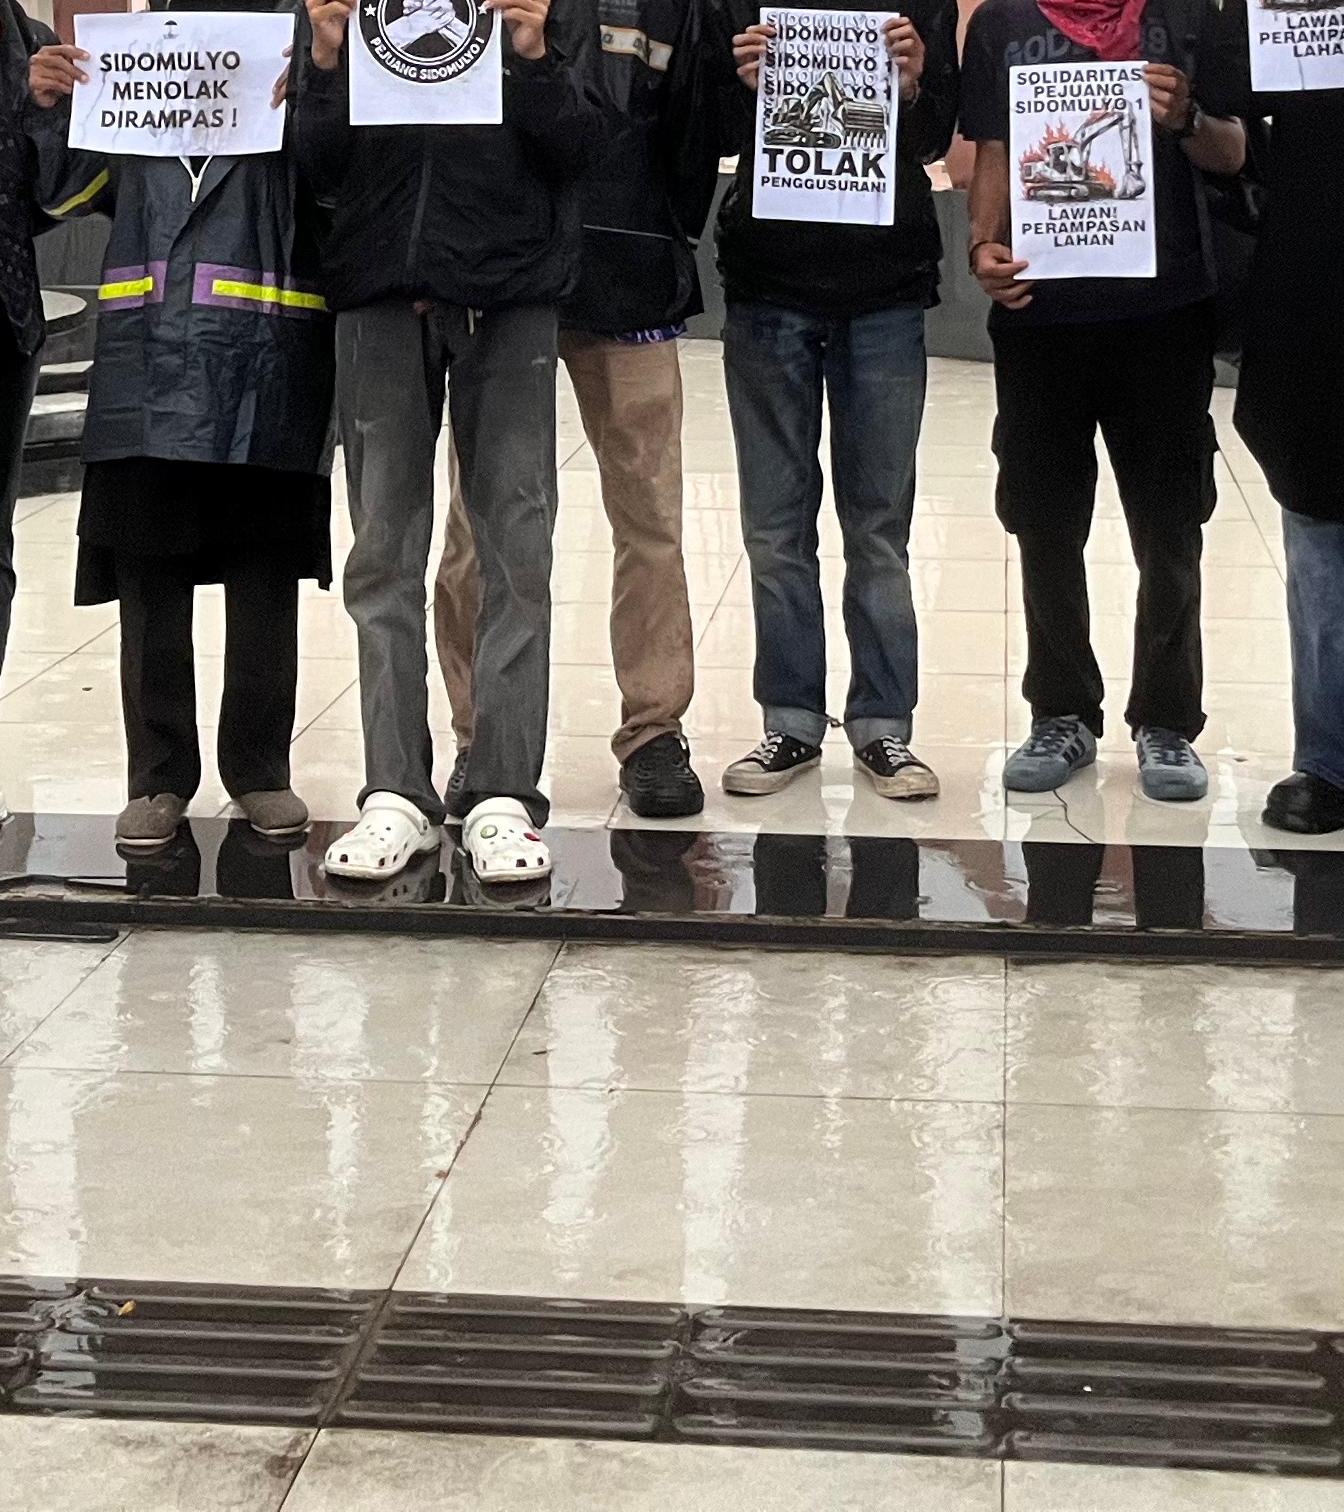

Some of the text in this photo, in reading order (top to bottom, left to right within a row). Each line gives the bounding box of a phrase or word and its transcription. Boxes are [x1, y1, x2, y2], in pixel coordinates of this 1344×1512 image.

[100, 51, 241, 72] SIDOMULYO
[369, 36, 418, 79] PEJUANG
[419, 42, 481, 81] SIDOMULYO
[1017, 68, 1143, 86] SOLIDARITAS
[112, 80, 229, 101] MENOLAK
[1034, 83, 1124, 99] PEJUANG
[1015, 98, 1143, 114] SIDOMULYO 1
[101, 109, 224, 129] DIRAMPAS
[762, 147, 886, 179] TOLAK
[1048, 206, 1117, 221] LAWAN!
[1022, 219, 1146, 235] PERAMPASAN
[1054, 233, 1114, 247] LAHAN
